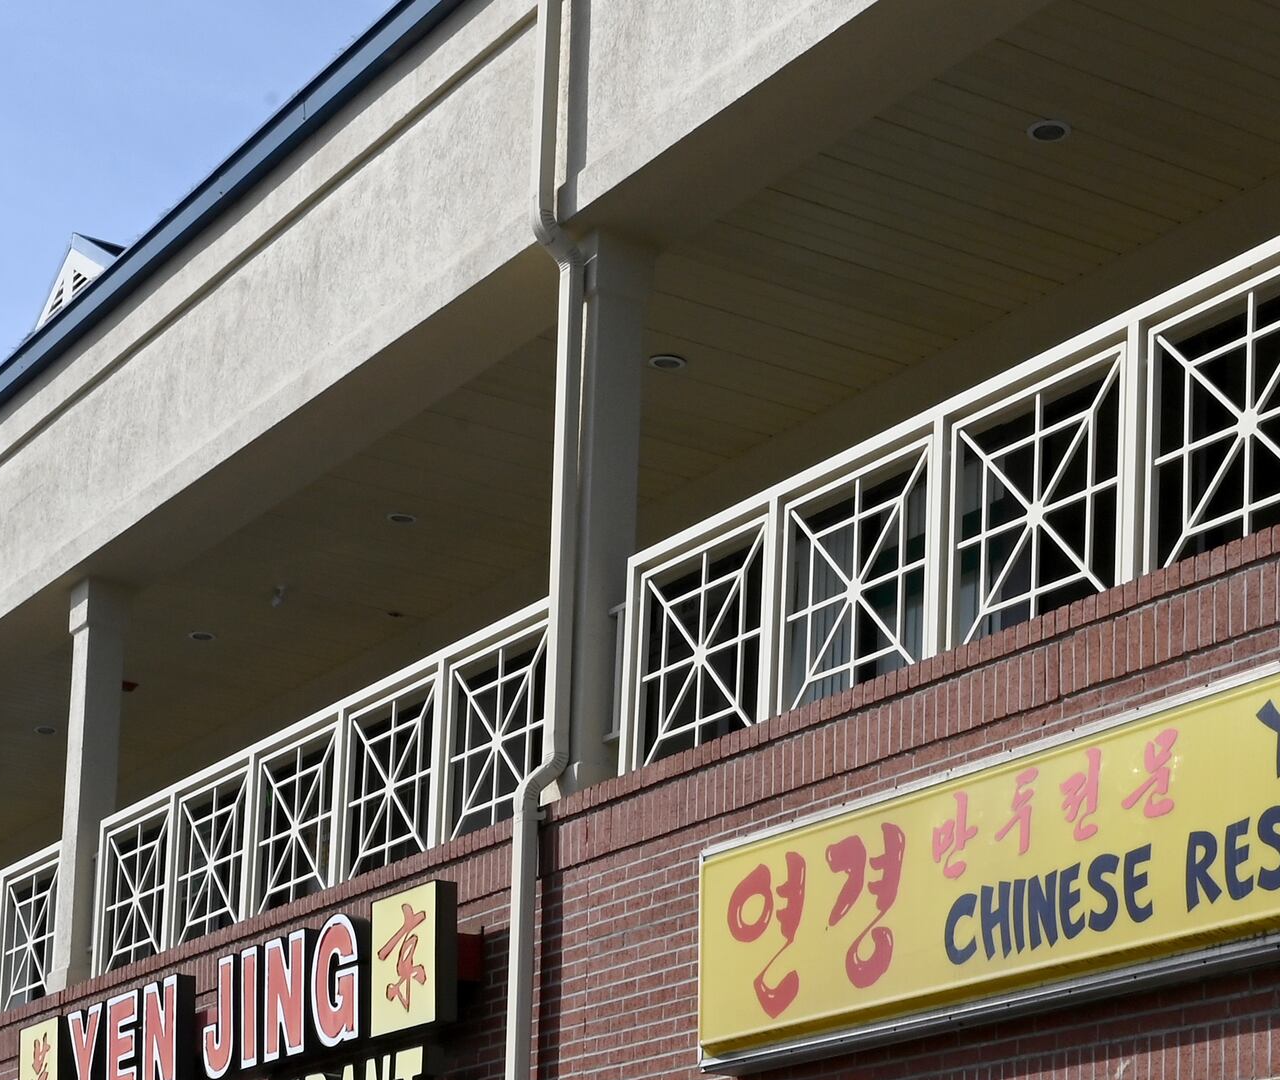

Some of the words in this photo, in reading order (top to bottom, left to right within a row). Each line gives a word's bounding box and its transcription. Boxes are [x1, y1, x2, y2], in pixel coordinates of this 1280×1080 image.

[376, 903, 427, 1012] 京
[727, 822, 906, 1019] 연경
[944, 843, 1154, 965] CHINESE
[202, 913, 359, 1079] JING
